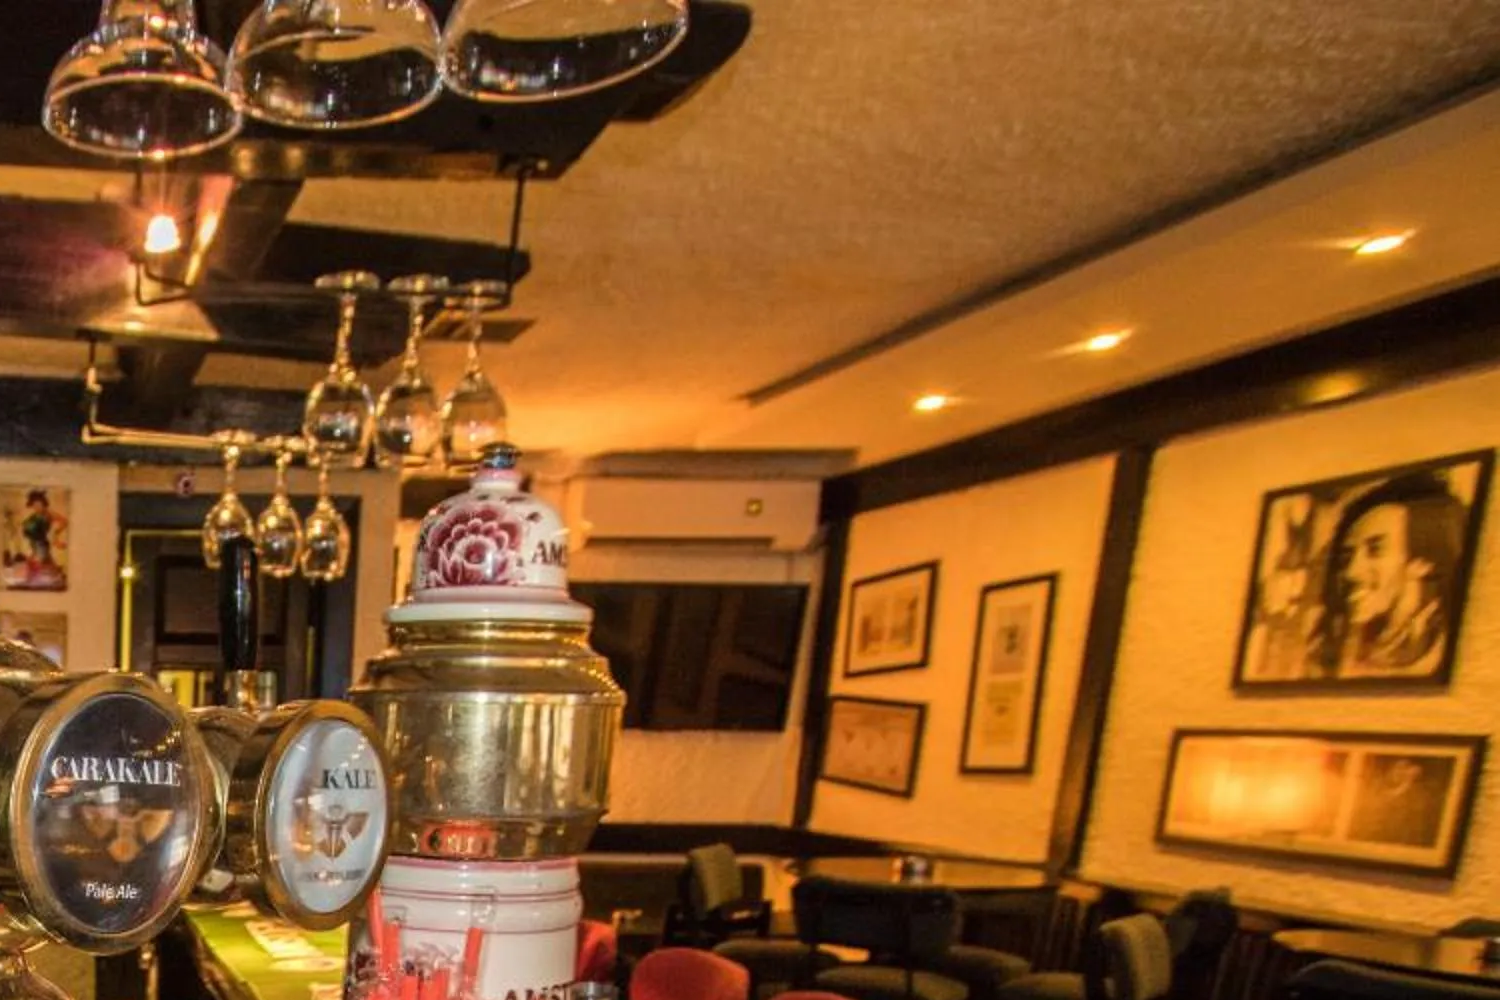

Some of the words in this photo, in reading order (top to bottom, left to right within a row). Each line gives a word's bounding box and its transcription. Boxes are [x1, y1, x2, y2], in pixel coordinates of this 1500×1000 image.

[51, 756, 182, 787] CARAKALE
[85, 882, 114, 900] Pale
[115, 883, 138, 900] Ale
